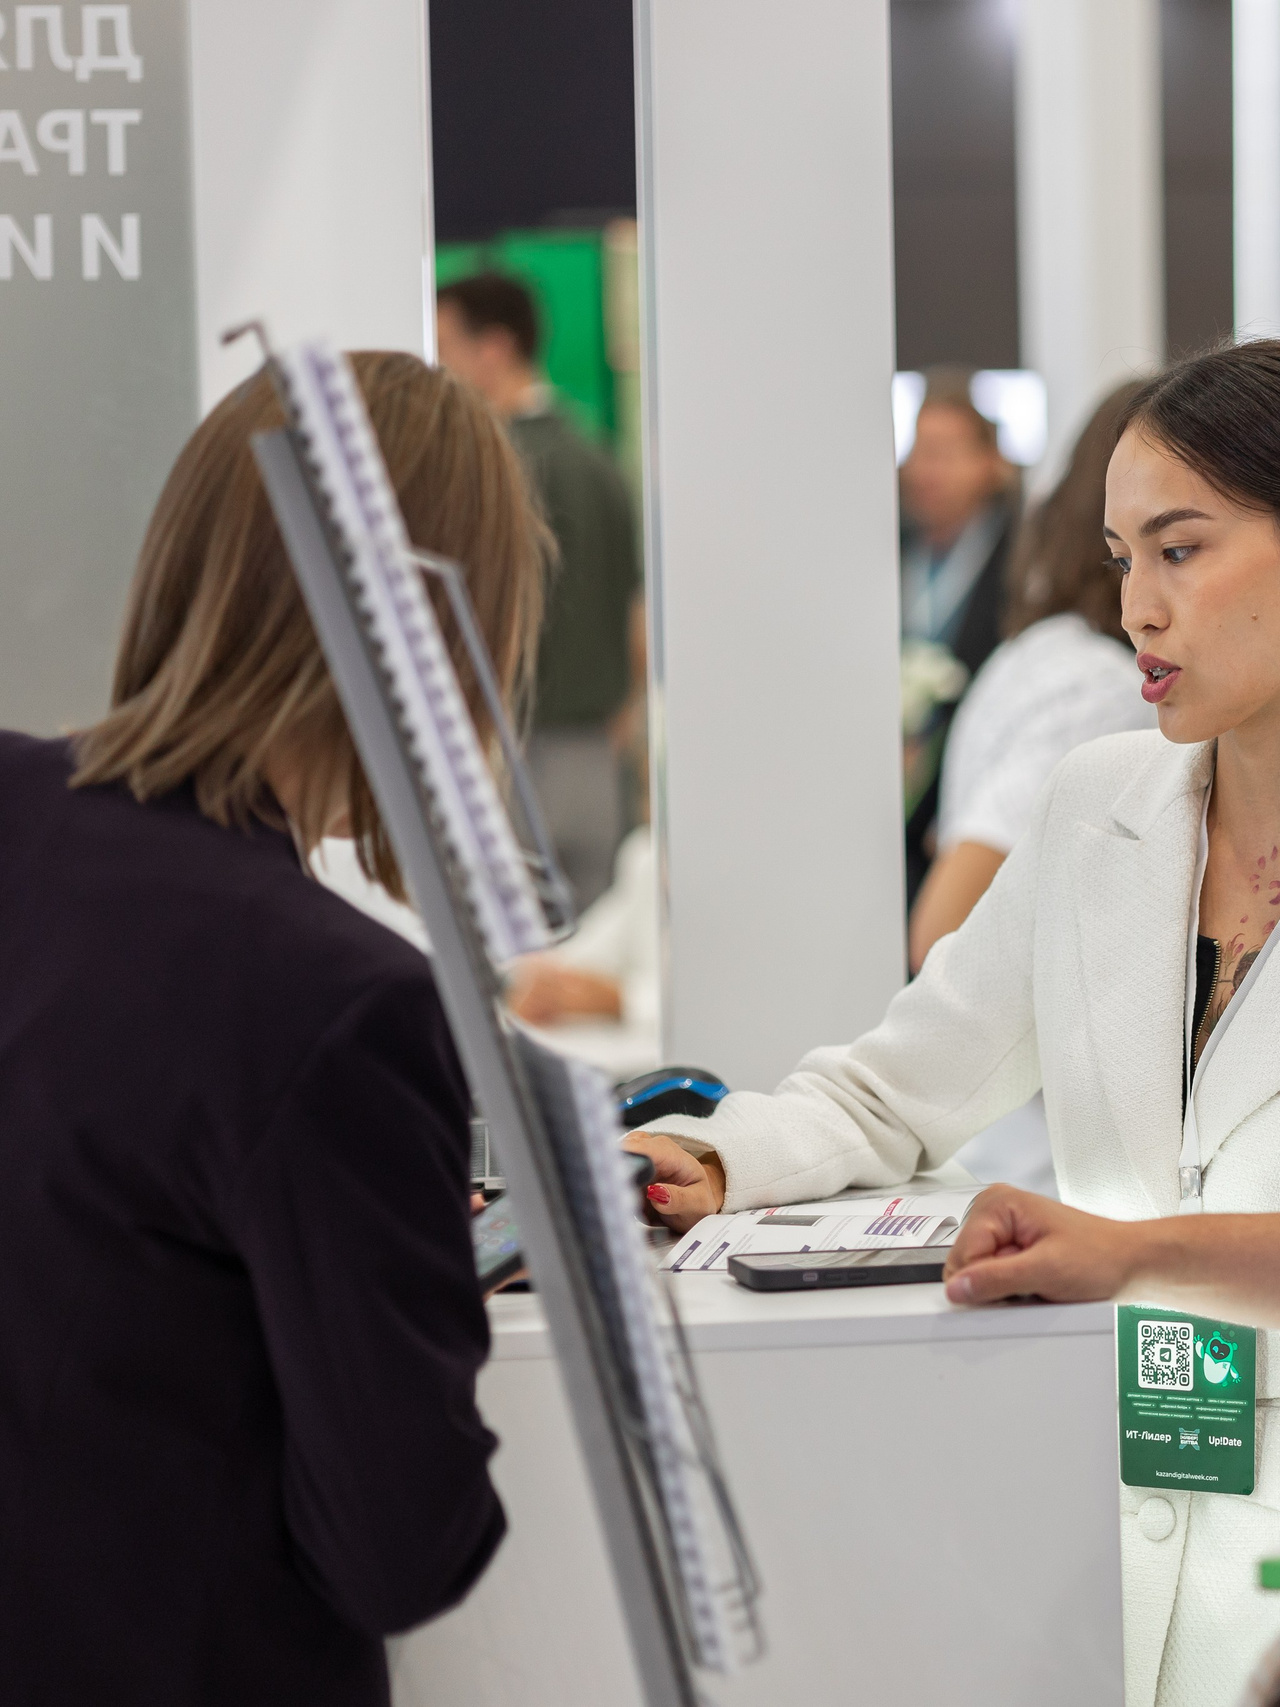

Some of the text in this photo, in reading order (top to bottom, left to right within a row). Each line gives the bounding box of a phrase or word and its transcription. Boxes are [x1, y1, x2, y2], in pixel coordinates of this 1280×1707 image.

[1126, 1430, 1172, 1443] ИТ-Лидер
[1208, 1435, 1242, 1447] Up!Date
[1155, 1470, 1219, 1482] kazandigitalweek.com
